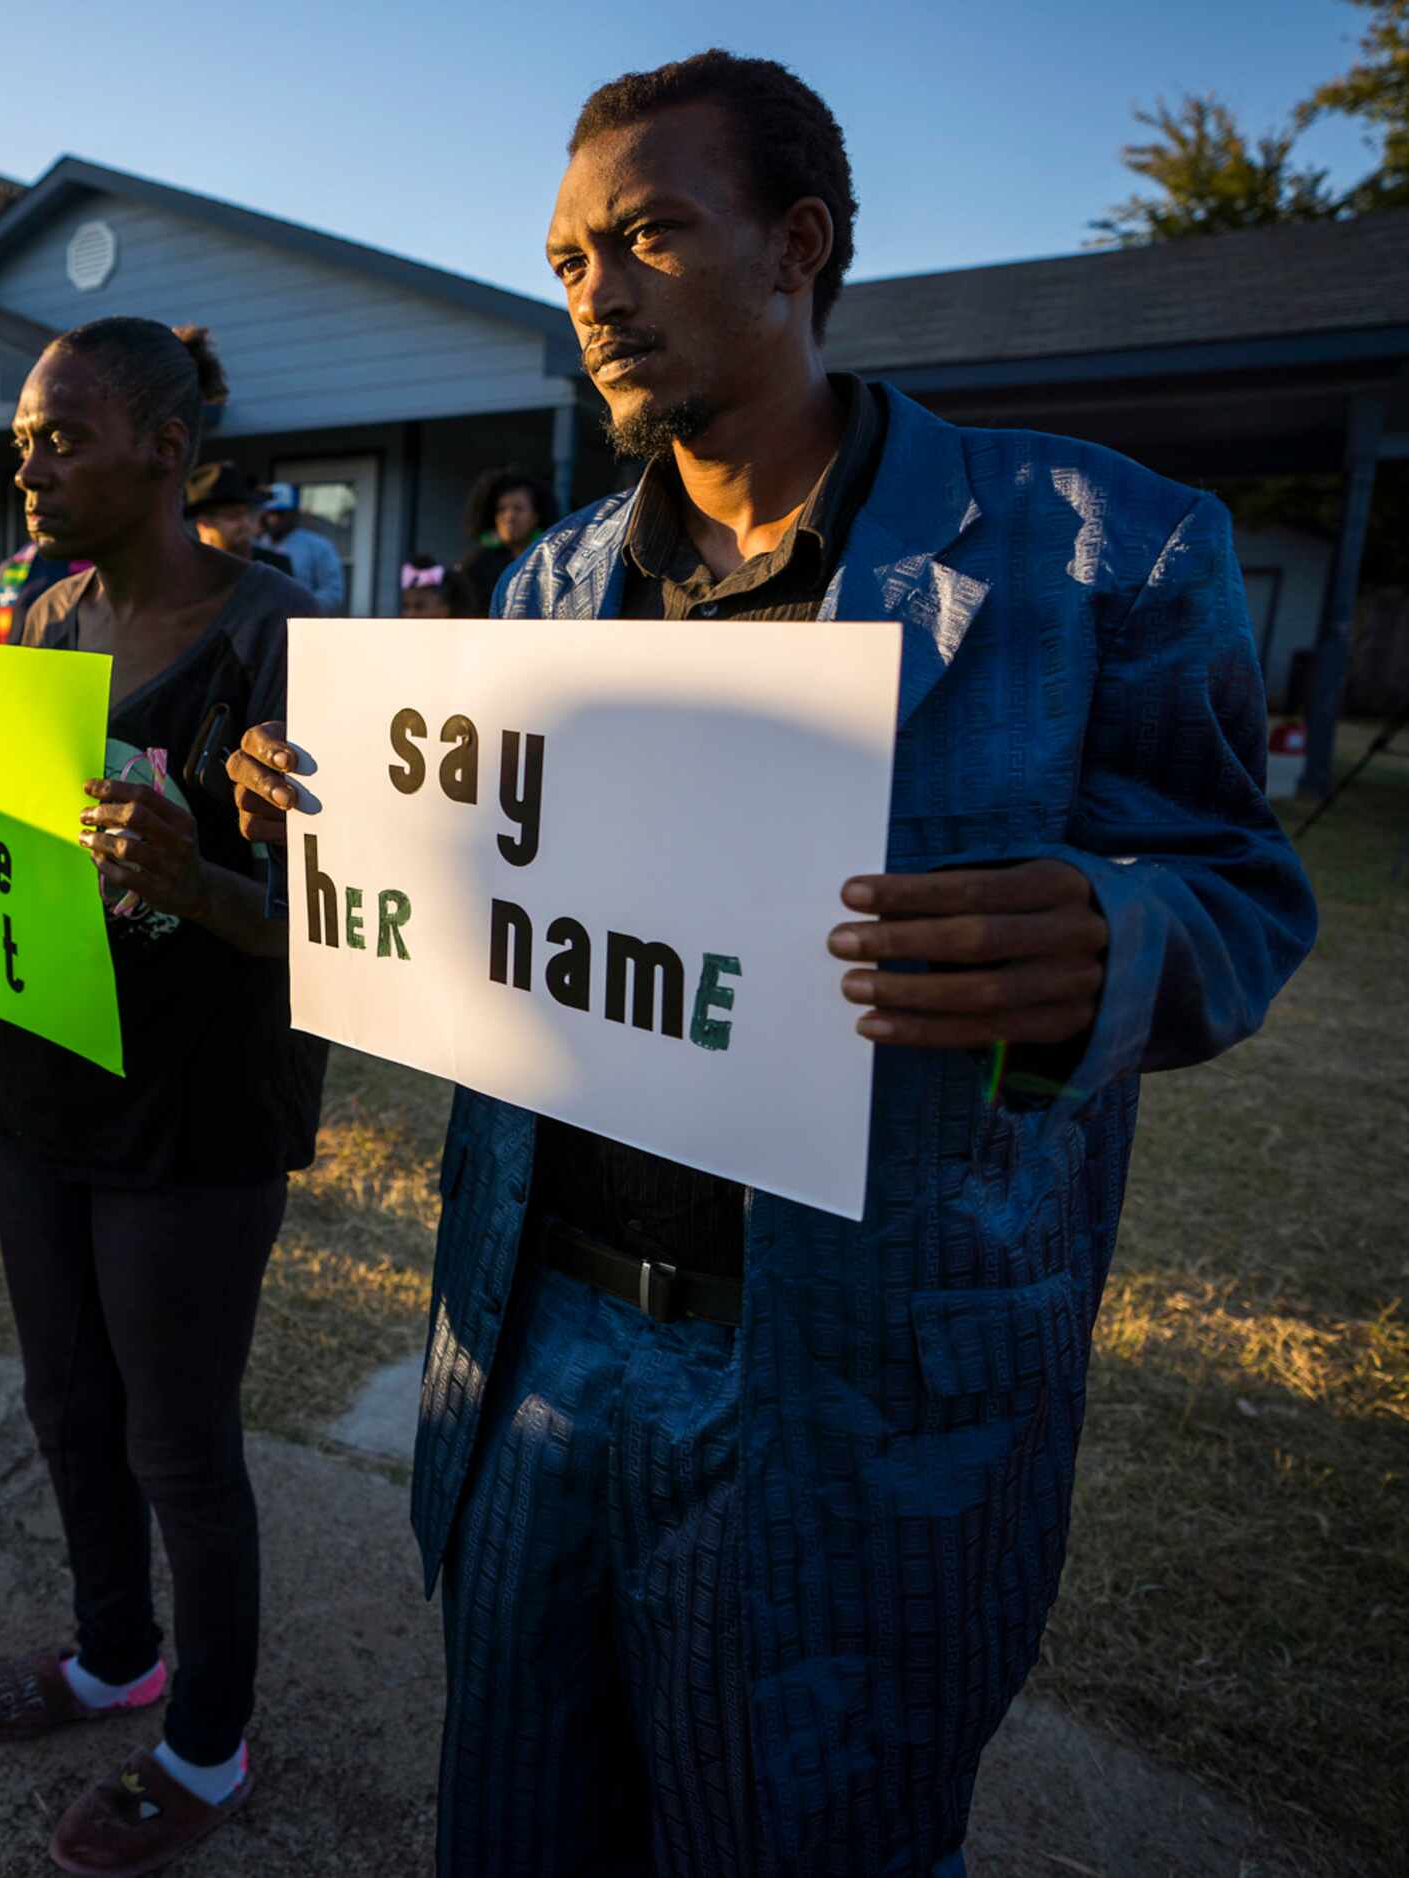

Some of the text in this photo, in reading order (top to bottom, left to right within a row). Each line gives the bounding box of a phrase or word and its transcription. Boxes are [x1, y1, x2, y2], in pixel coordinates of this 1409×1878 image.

[388, 707, 546, 867] say
[303, 833, 743, 1052] hER namE
